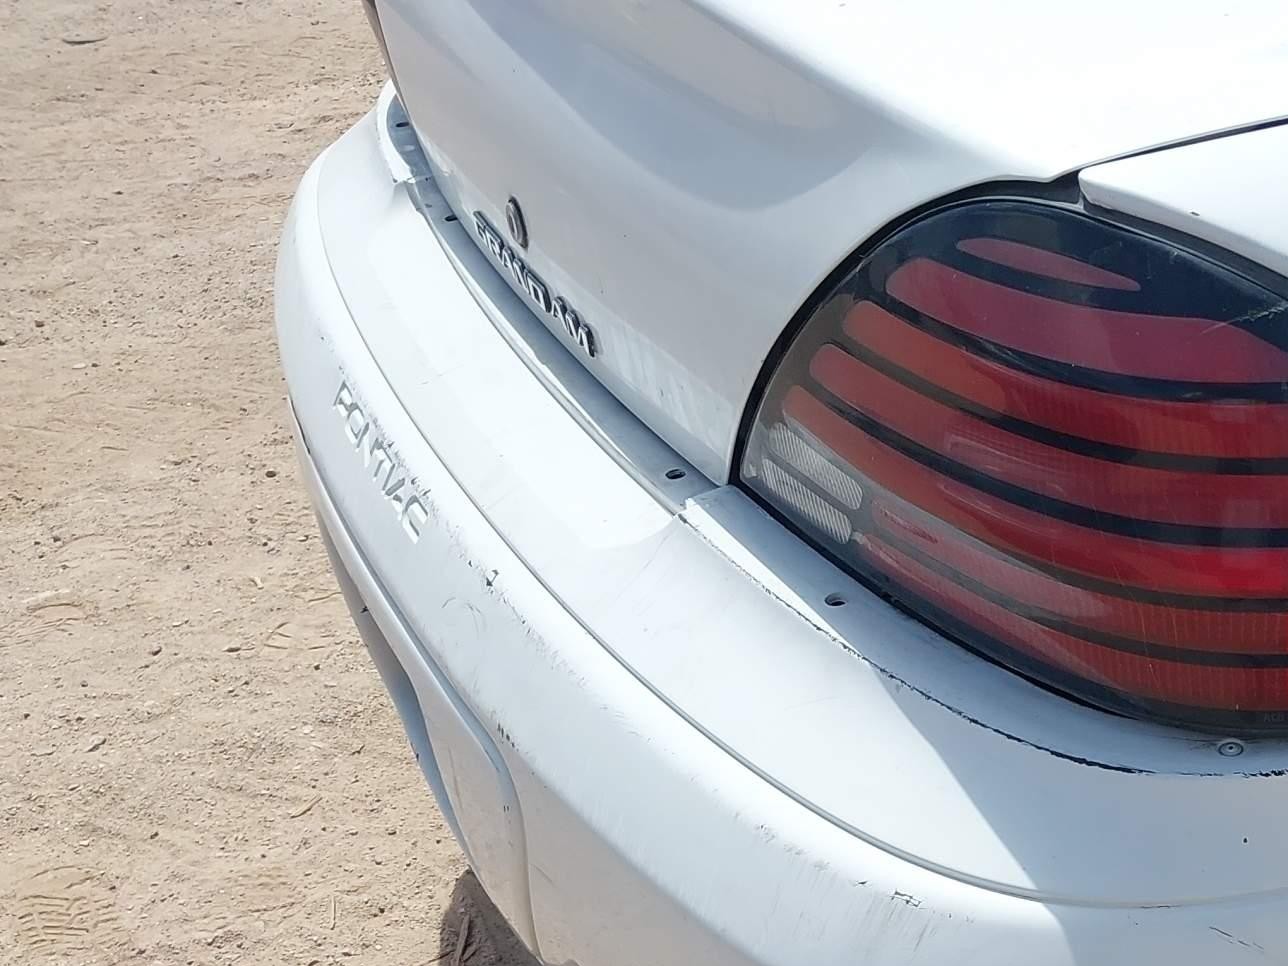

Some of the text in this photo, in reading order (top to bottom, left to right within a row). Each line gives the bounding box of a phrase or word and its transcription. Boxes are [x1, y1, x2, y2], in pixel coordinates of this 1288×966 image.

[472, 210, 597, 359] GRAND AM
[332, 380, 429, 545] PONTIAC
